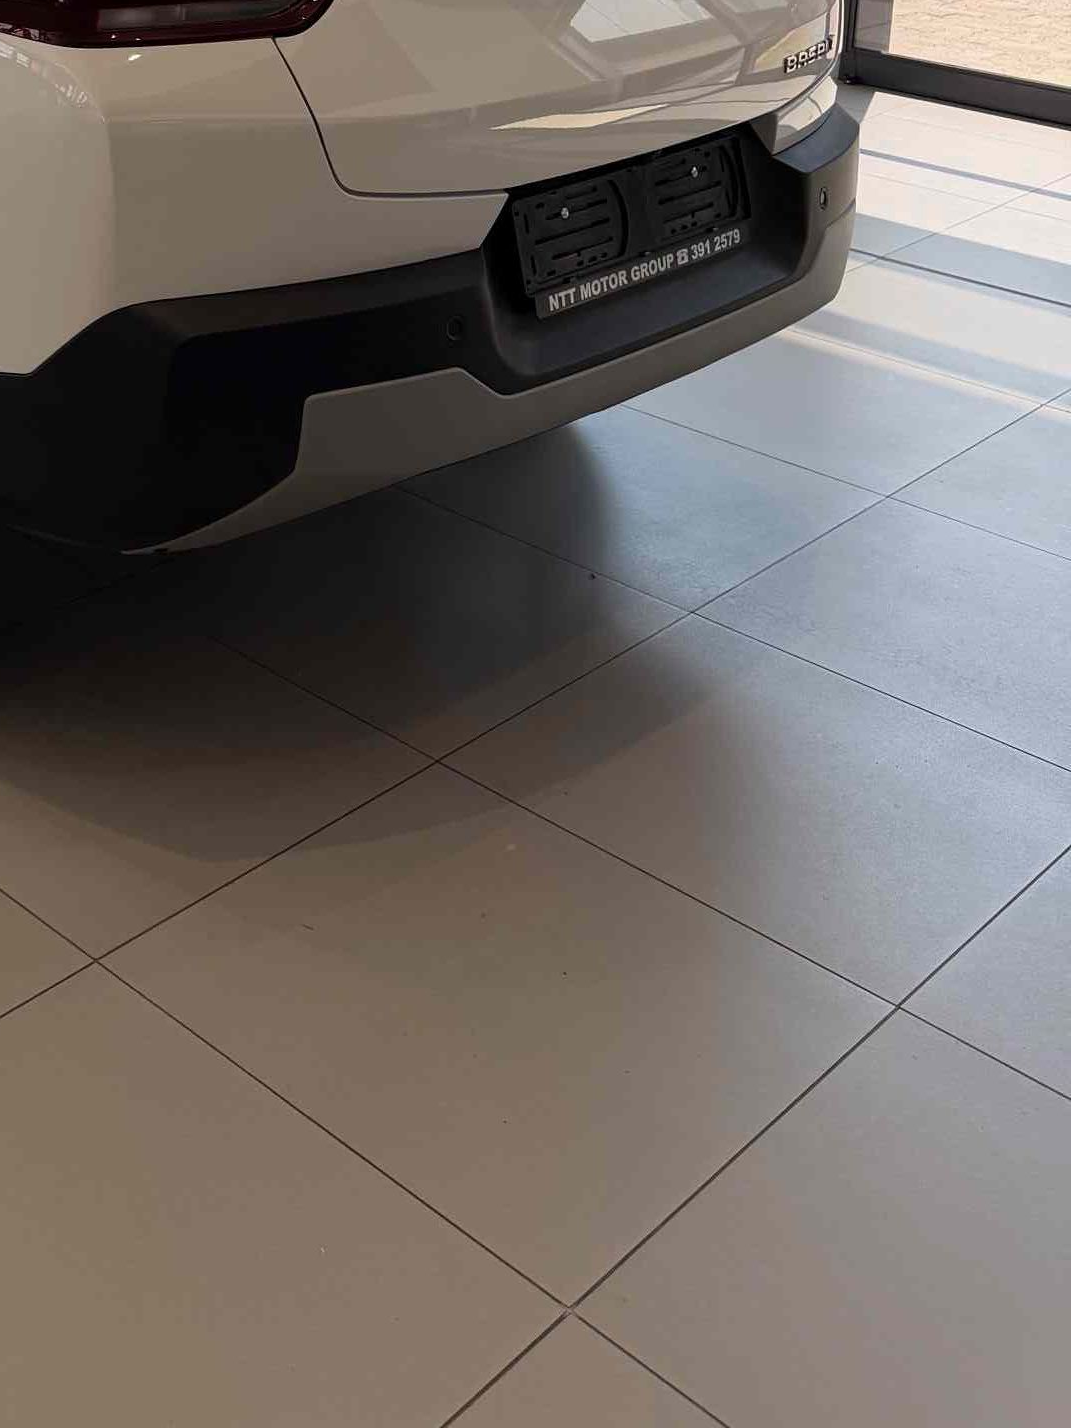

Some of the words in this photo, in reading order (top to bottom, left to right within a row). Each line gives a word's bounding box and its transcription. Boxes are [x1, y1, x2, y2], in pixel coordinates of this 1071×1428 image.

[548, 288, 577, 312] NTT
[580, 270, 629, 301] MOTOR
[631, 254, 674, 282] GROUP
[691, 240, 711, 260] 391
[714, 228, 741, 252] 2579
